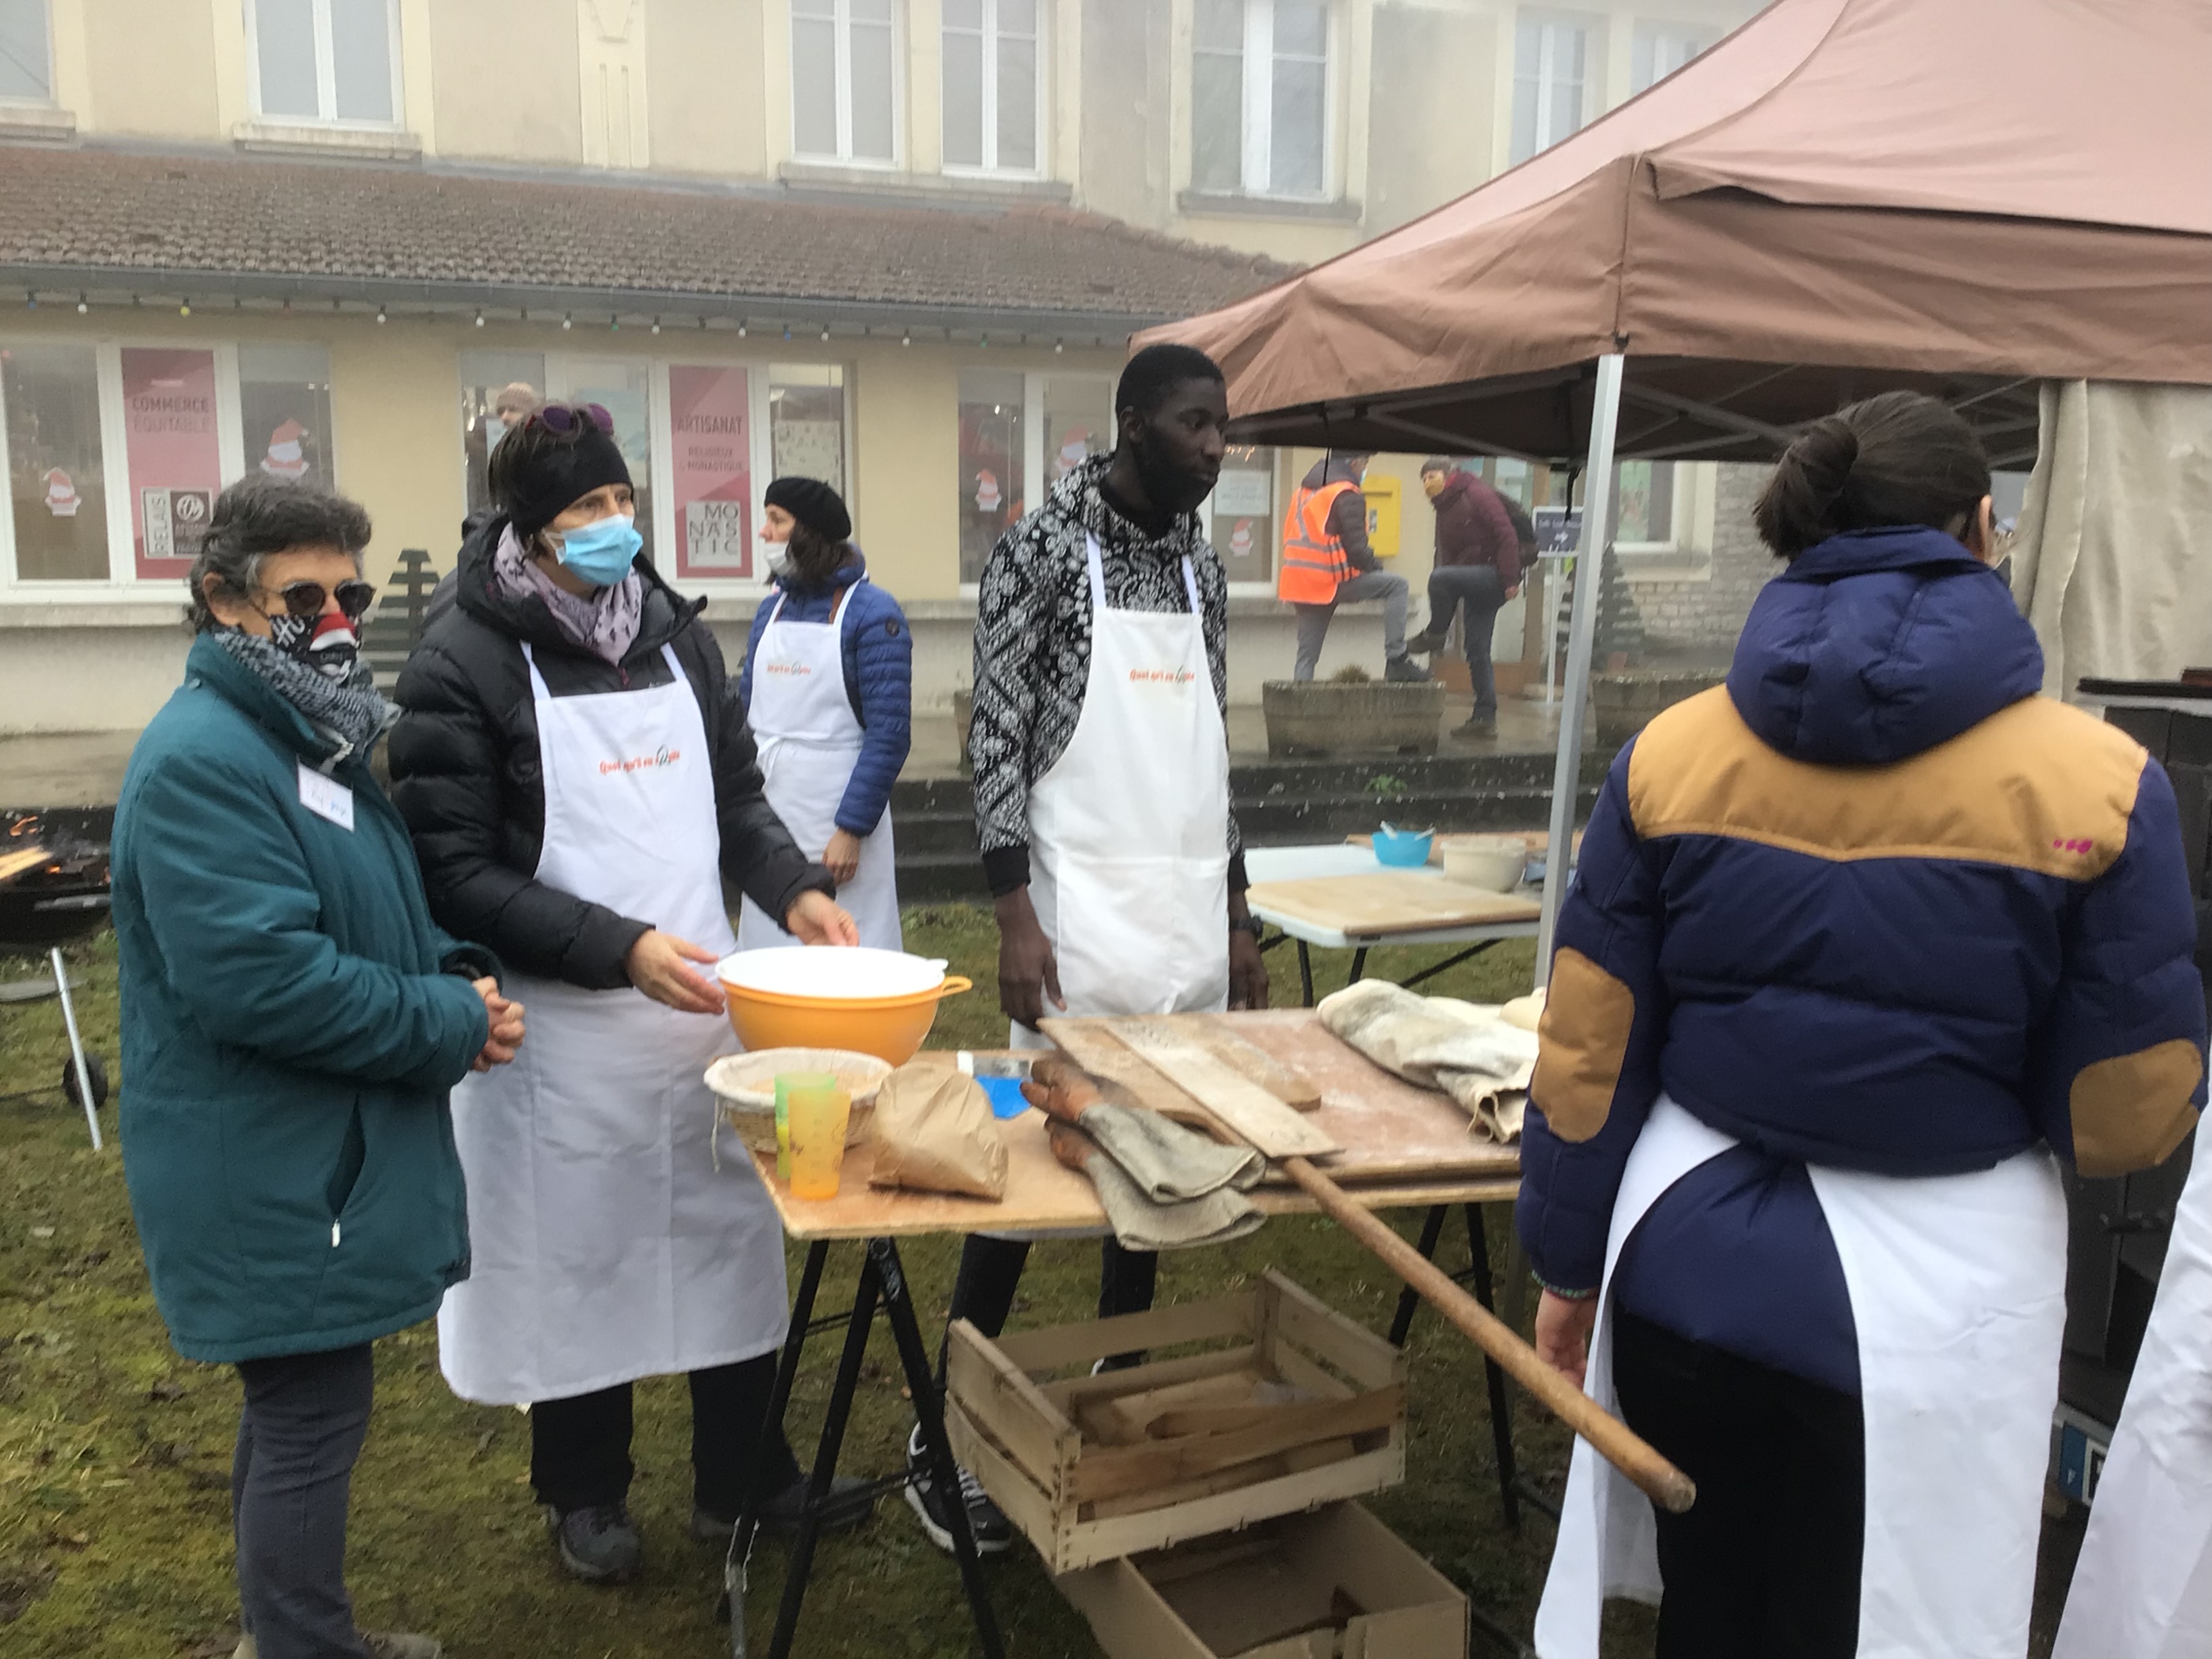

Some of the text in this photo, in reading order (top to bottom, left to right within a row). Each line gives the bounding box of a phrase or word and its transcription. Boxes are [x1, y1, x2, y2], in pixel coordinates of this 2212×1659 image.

[133, 396, 209, 413] COMMERCE
[678, 414, 743, 435] ARTISANAT
[151, 497, 169, 554] RELAIS
